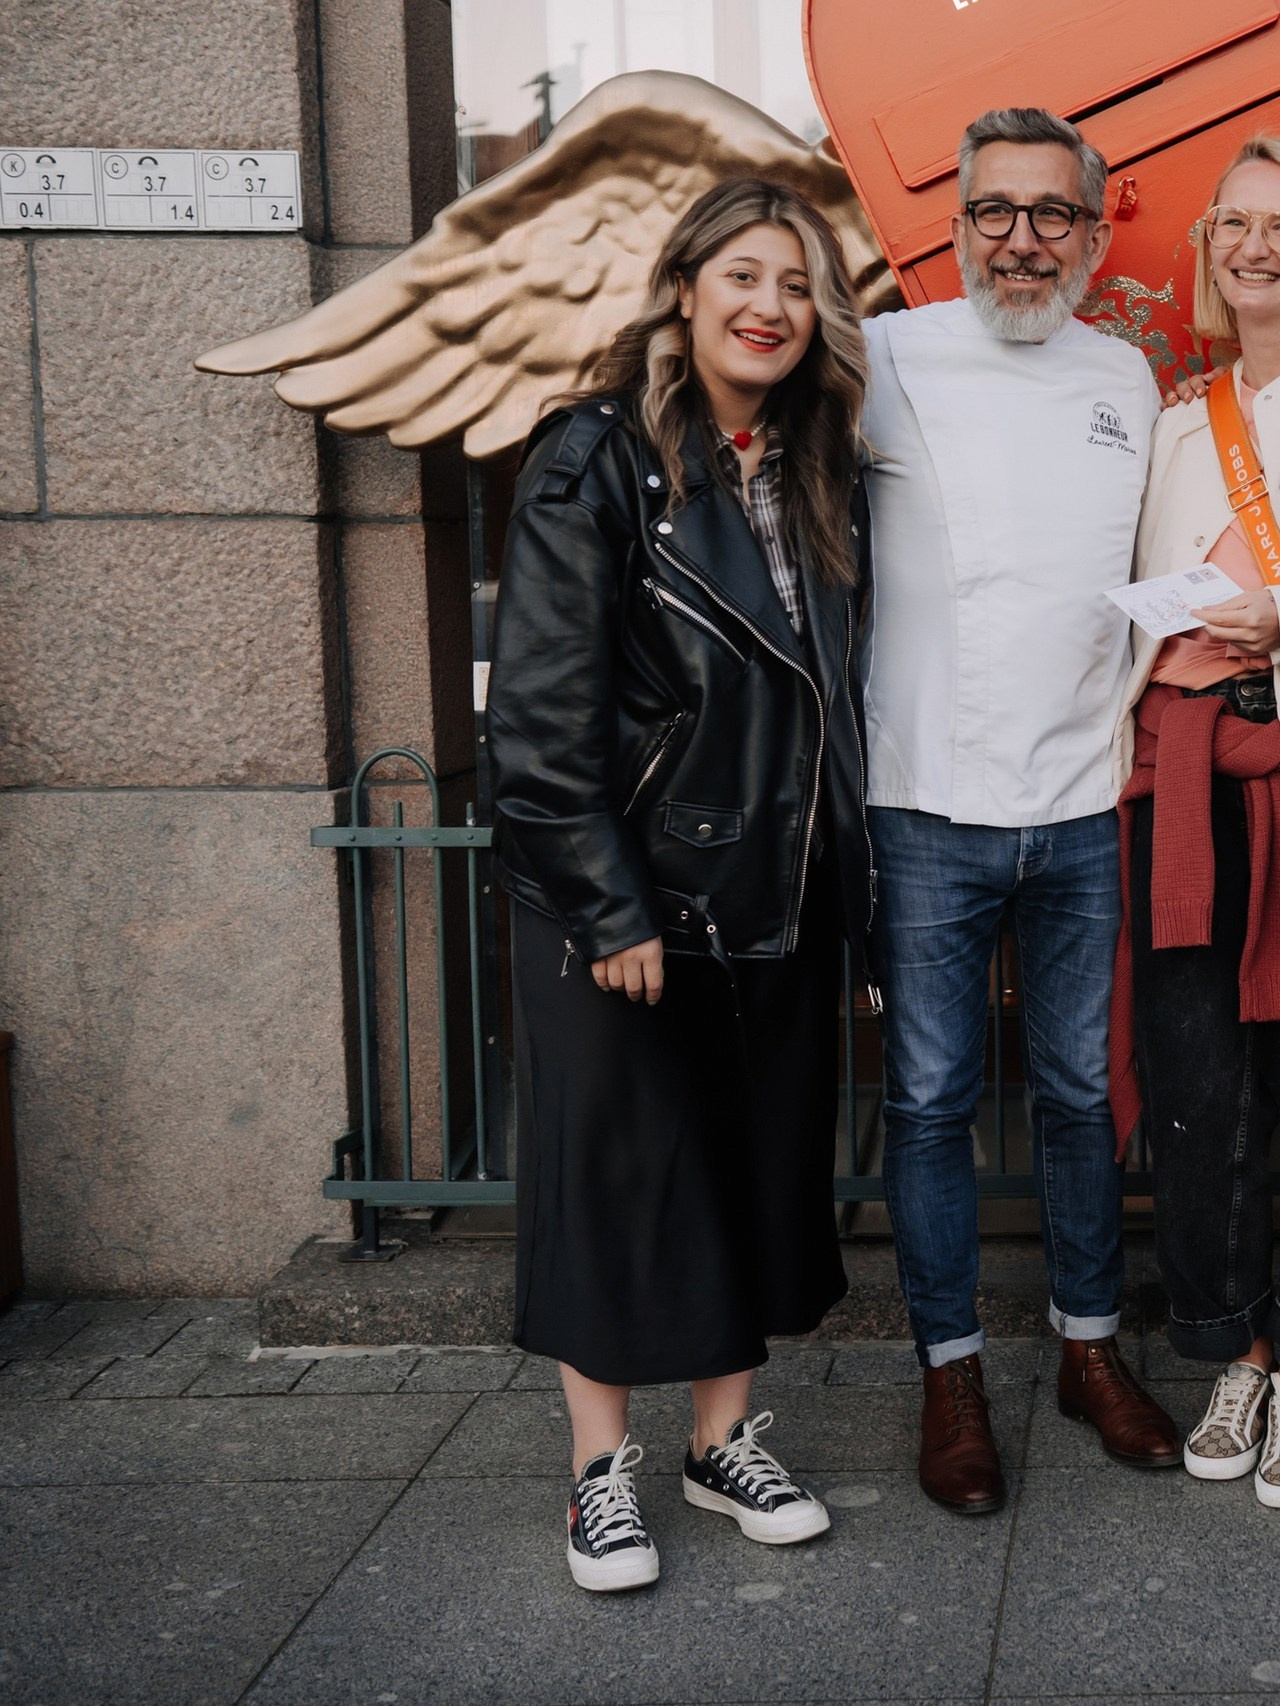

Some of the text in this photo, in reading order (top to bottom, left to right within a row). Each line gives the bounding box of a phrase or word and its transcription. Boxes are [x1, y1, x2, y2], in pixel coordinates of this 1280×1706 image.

[10, 160, 18, 172] K
[111, 162, 120, 174] C
[212, 163, 220, 175] C
[41, 174, 65, 191] 3.7
[144, 176, 167, 192] 3.7
[244, 177, 267, 194] 3.7
[19, 202, 44, 218] 0.4
